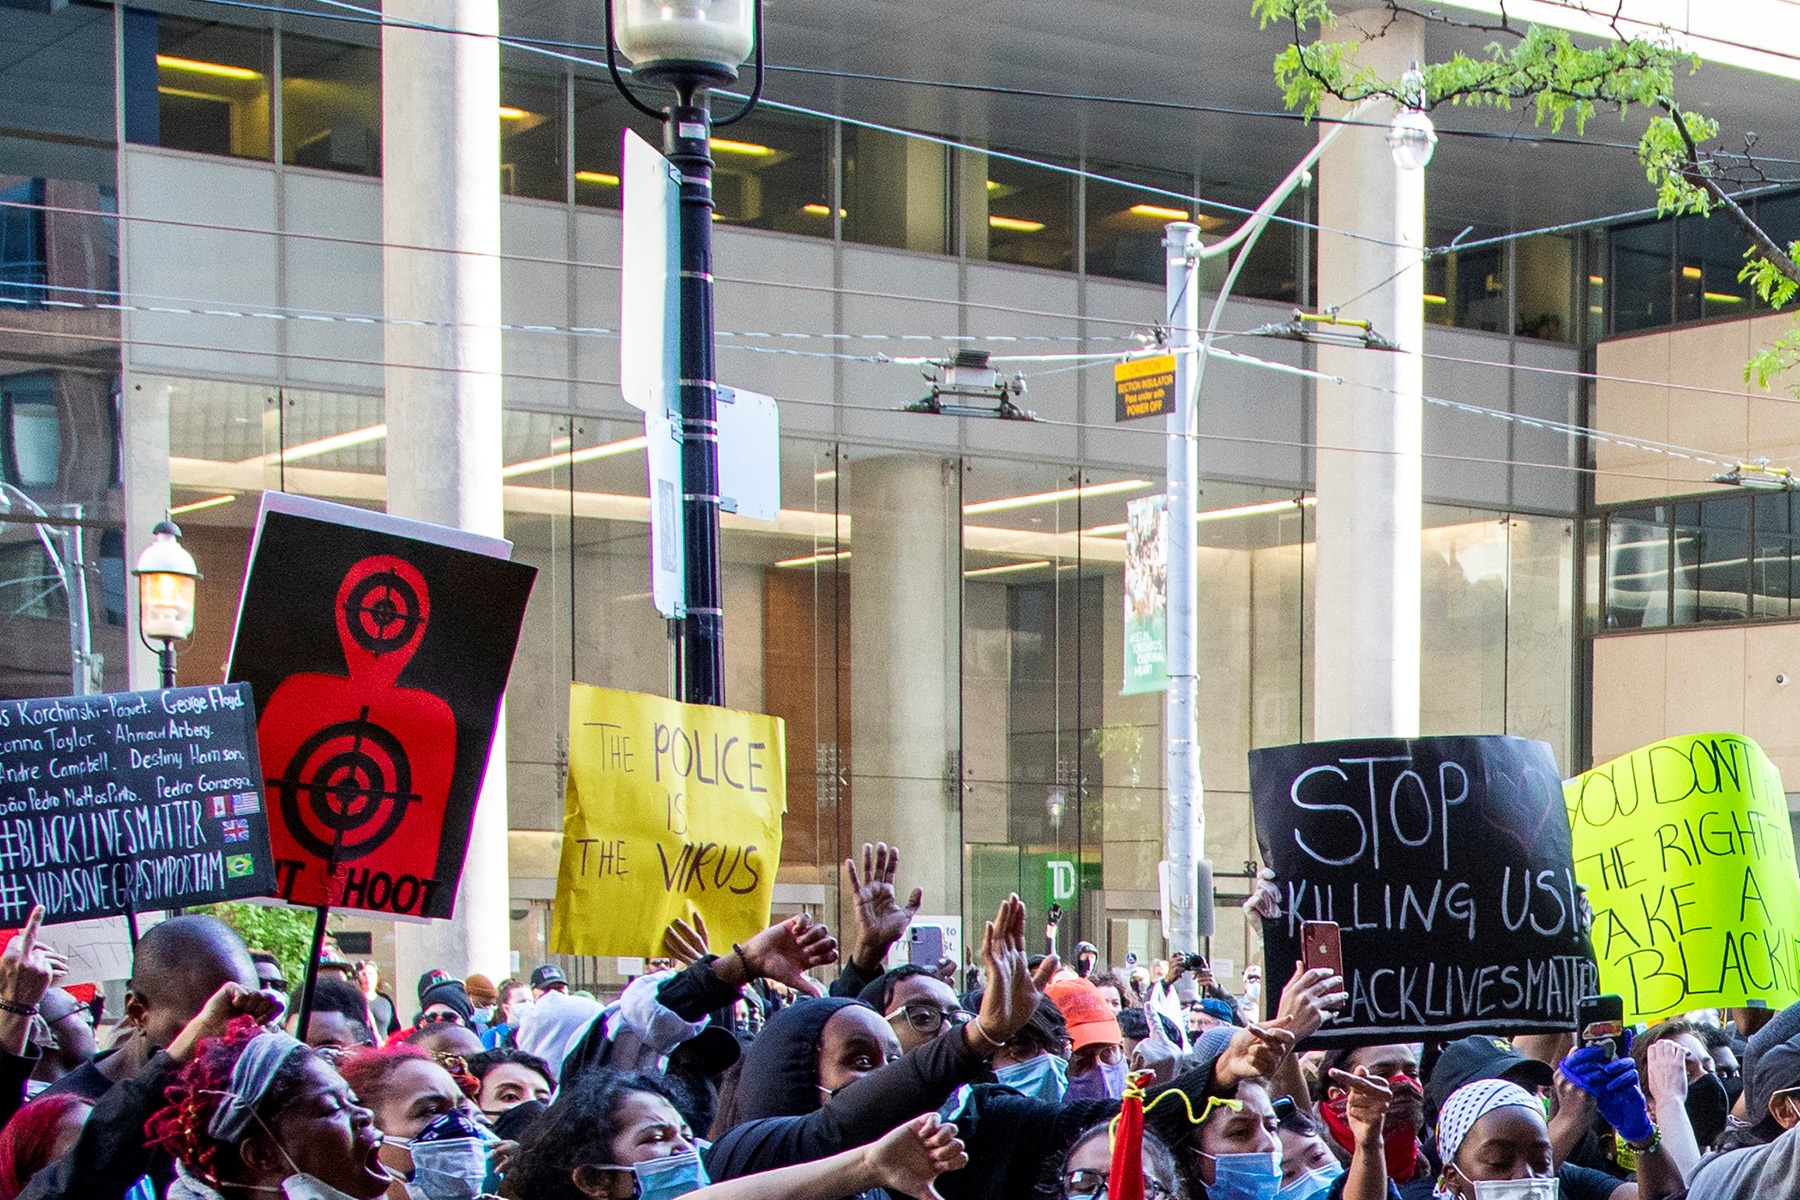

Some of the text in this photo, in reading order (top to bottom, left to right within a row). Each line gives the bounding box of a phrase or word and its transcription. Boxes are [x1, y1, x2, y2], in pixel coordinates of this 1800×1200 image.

[1127, 400, 1163, 416] POWER OFF
[161, 690, 208, 715] George
[130, 747, 184, 770] Destiny
[583, 722, 768, 793] THE POLICE
[1648, 738, 1757, 805] DON'T
[27, 787, 60, 811] Pedro
[157, 776, 194, 799] Pedro
[667, 793, 688, 835] IS
[1290, 756, 1469, 871] STOP
[576, 838, 759, 895] THE VIRUS
[1243, 860, 1258, 876] 33
[1574, 838, 1647, 892] THE
[1654, 810, 1767, 873] RIGHT
[1047, 860, 1075, 899] TD
[1286, 865, 1580, 943] KILLING US!
[1740, 865, 1773, 926] A
